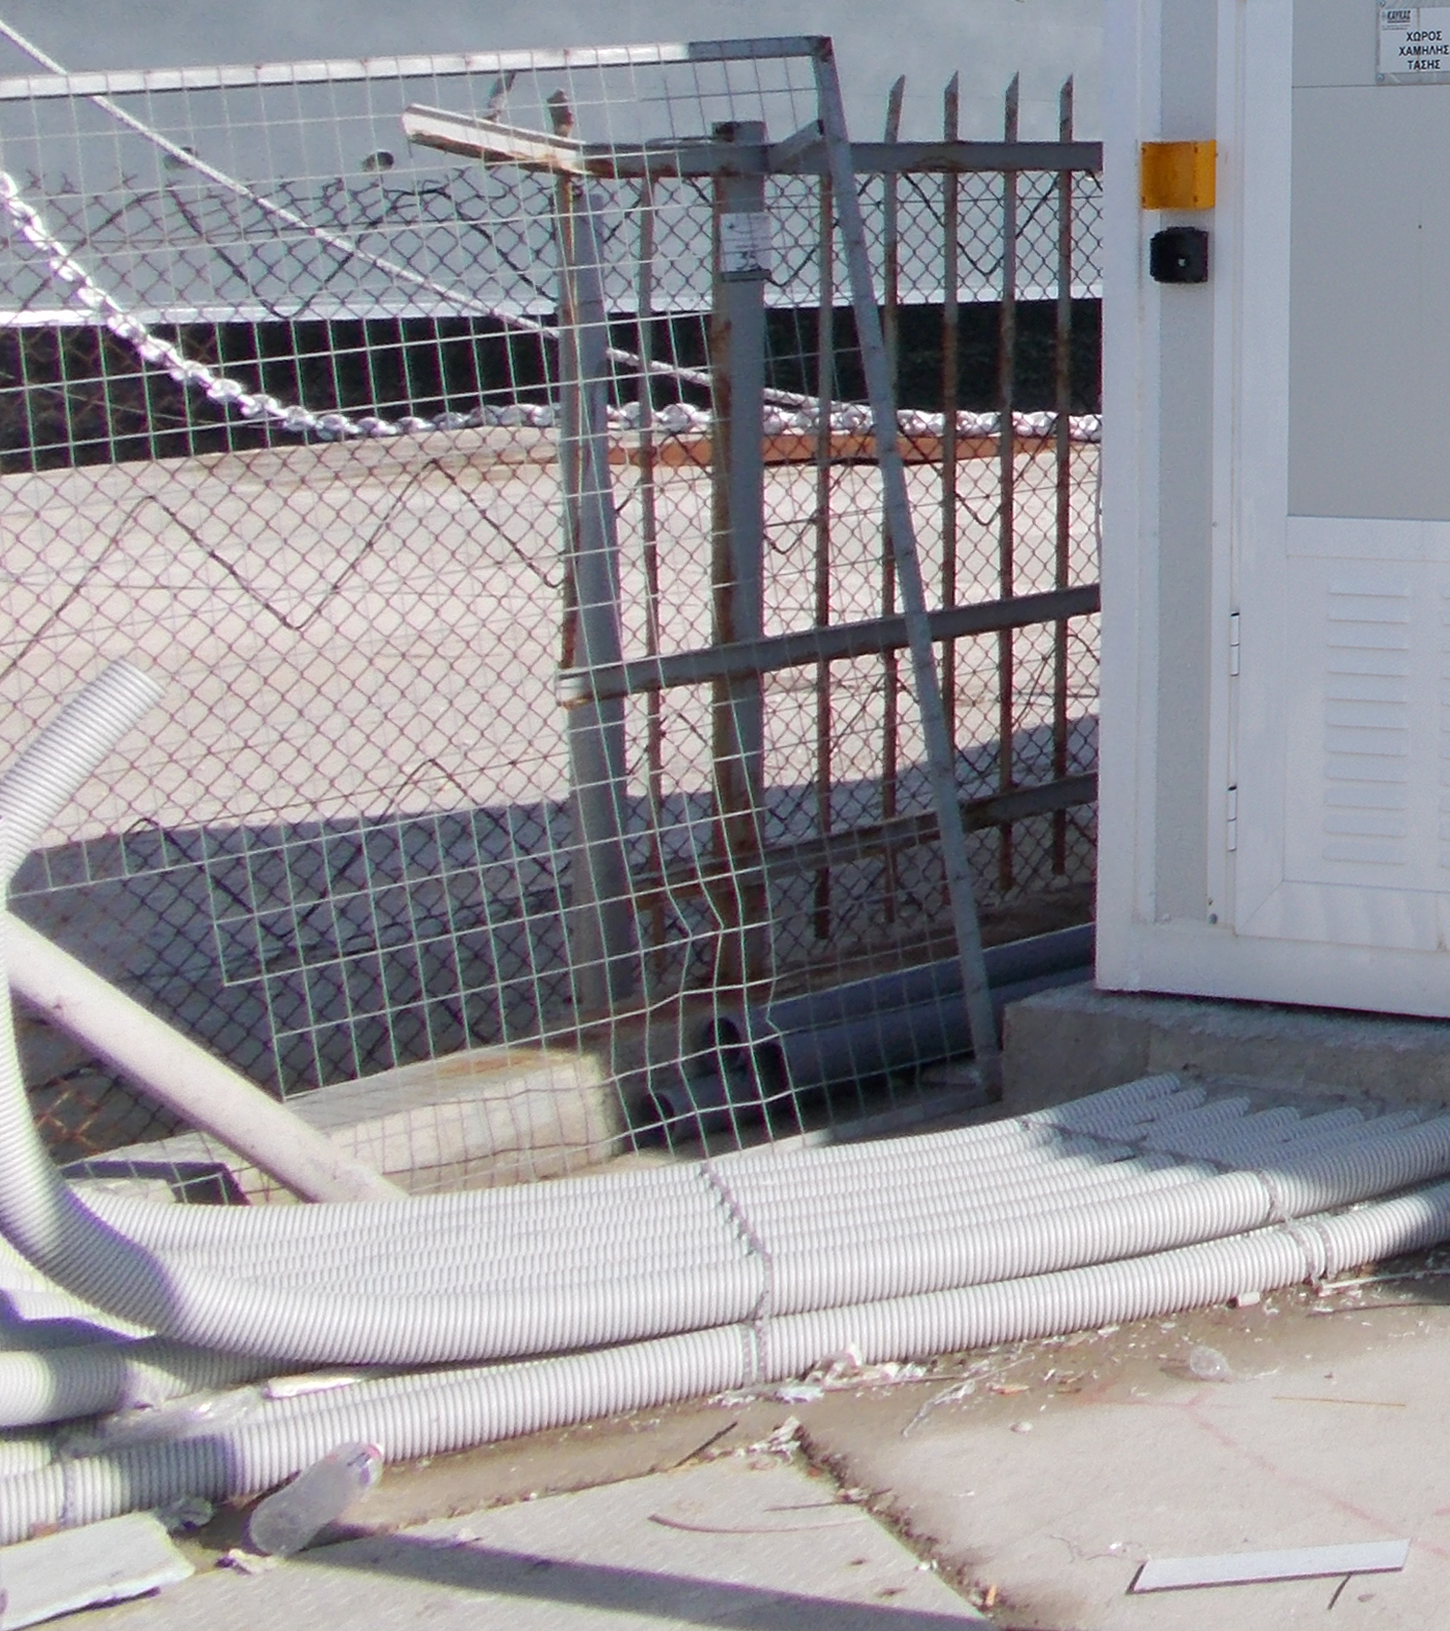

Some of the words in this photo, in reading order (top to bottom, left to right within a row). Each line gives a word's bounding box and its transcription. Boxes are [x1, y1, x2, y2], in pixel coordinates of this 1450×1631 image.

[1406, 30, 1443, 42] ΧΩΡΟΣ
[1398, 44, 1450, 57] ΧΑΜΗΛΗΣ
[1407, 59, 1441, 71] ΤΑΣΗΣ
